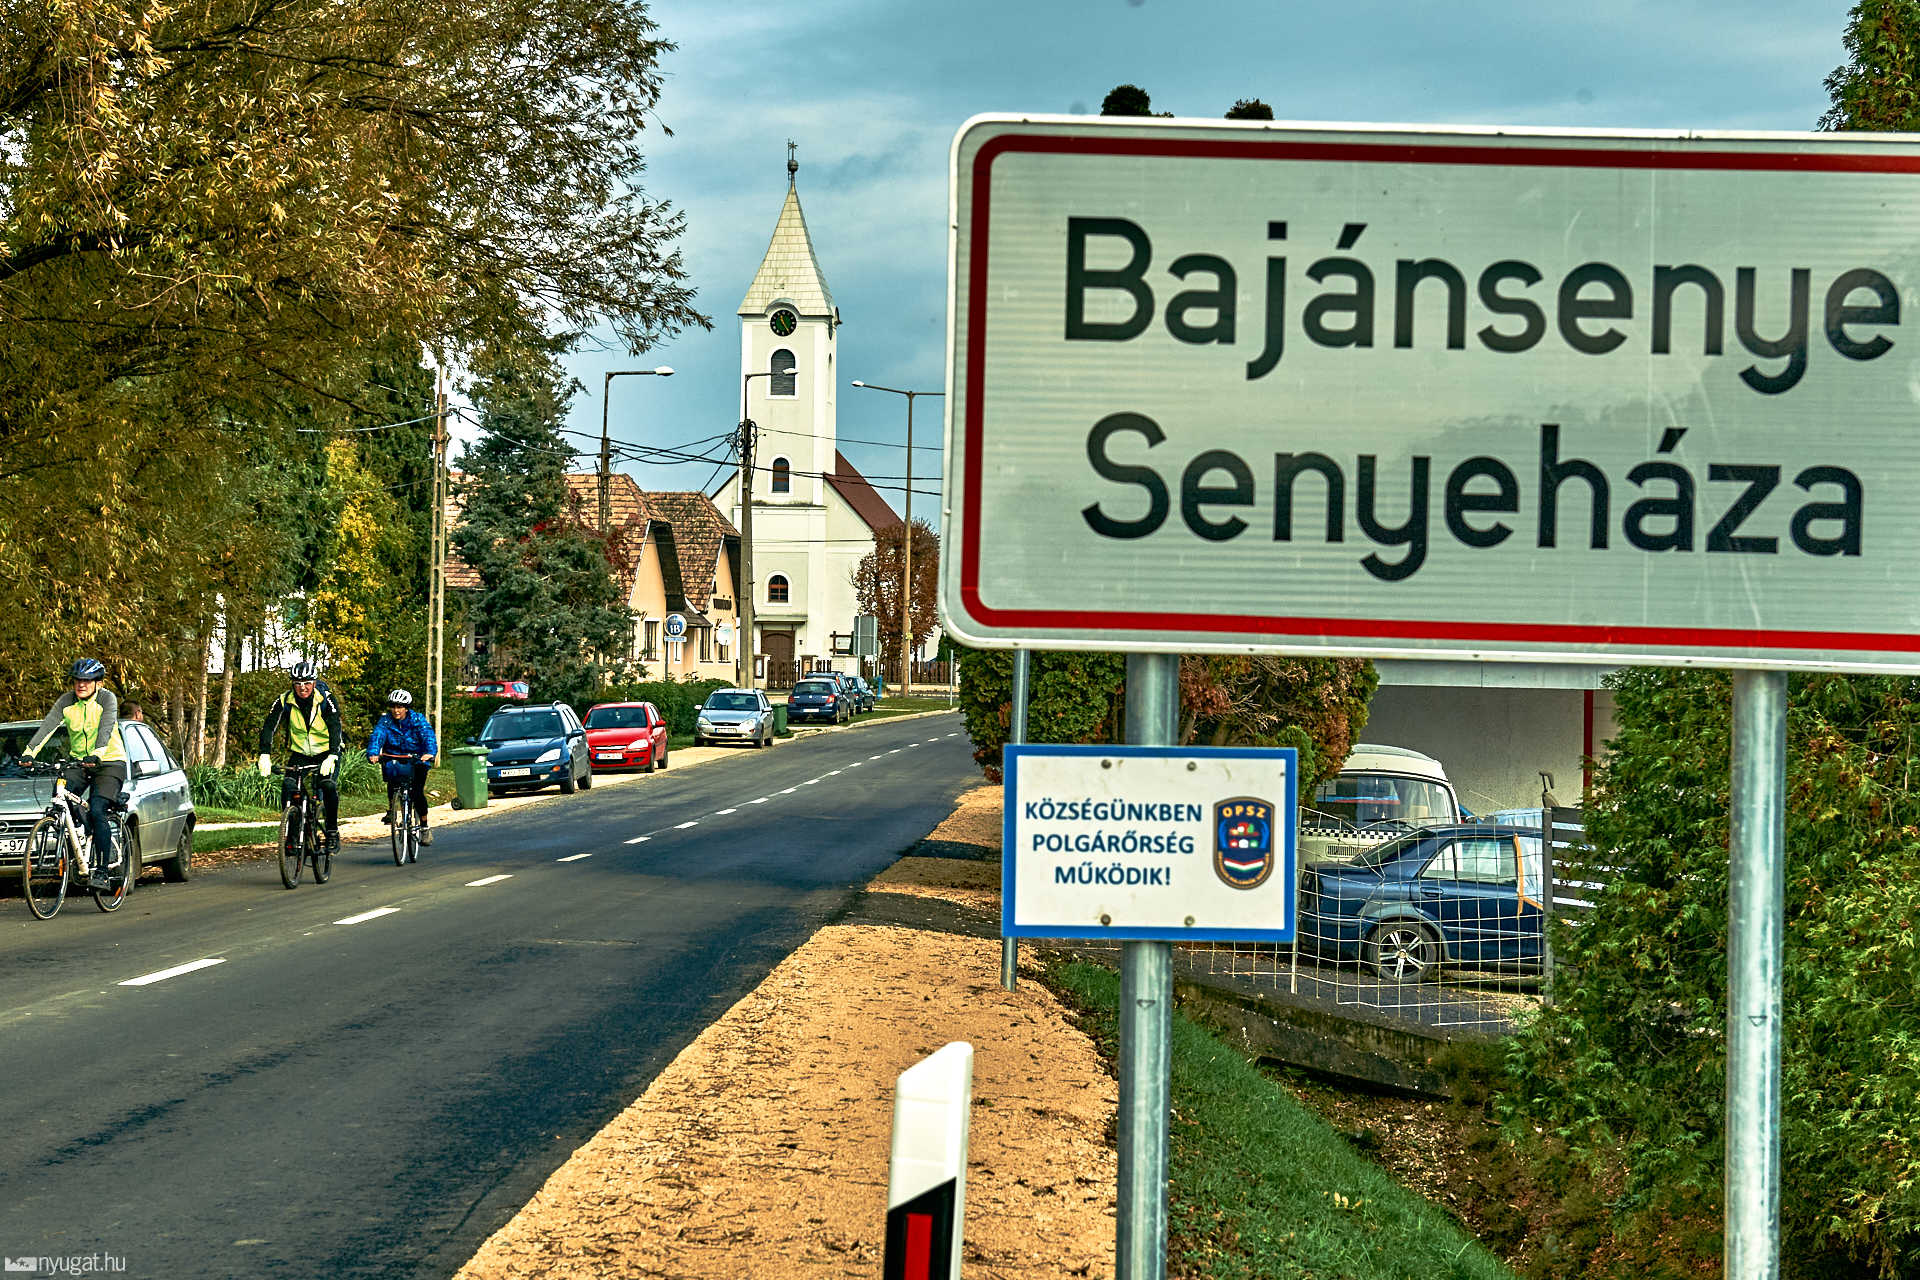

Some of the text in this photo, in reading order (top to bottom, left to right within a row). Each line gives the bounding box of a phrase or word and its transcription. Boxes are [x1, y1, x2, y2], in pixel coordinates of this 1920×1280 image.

[1064, 216, 1901, 395] Bajánsenye
[1081, 411, 1864, 581] Senyeháza
[1025, 798, 1202, 822] KÖZSÉGÜNKBEN
[1222, 805, 1267, 818] OPSZ
[1033, 830, 1194, 854] POLGÁRŐRSÉG
[1055, 862, 1171, 886] MŰKÖDIK!
